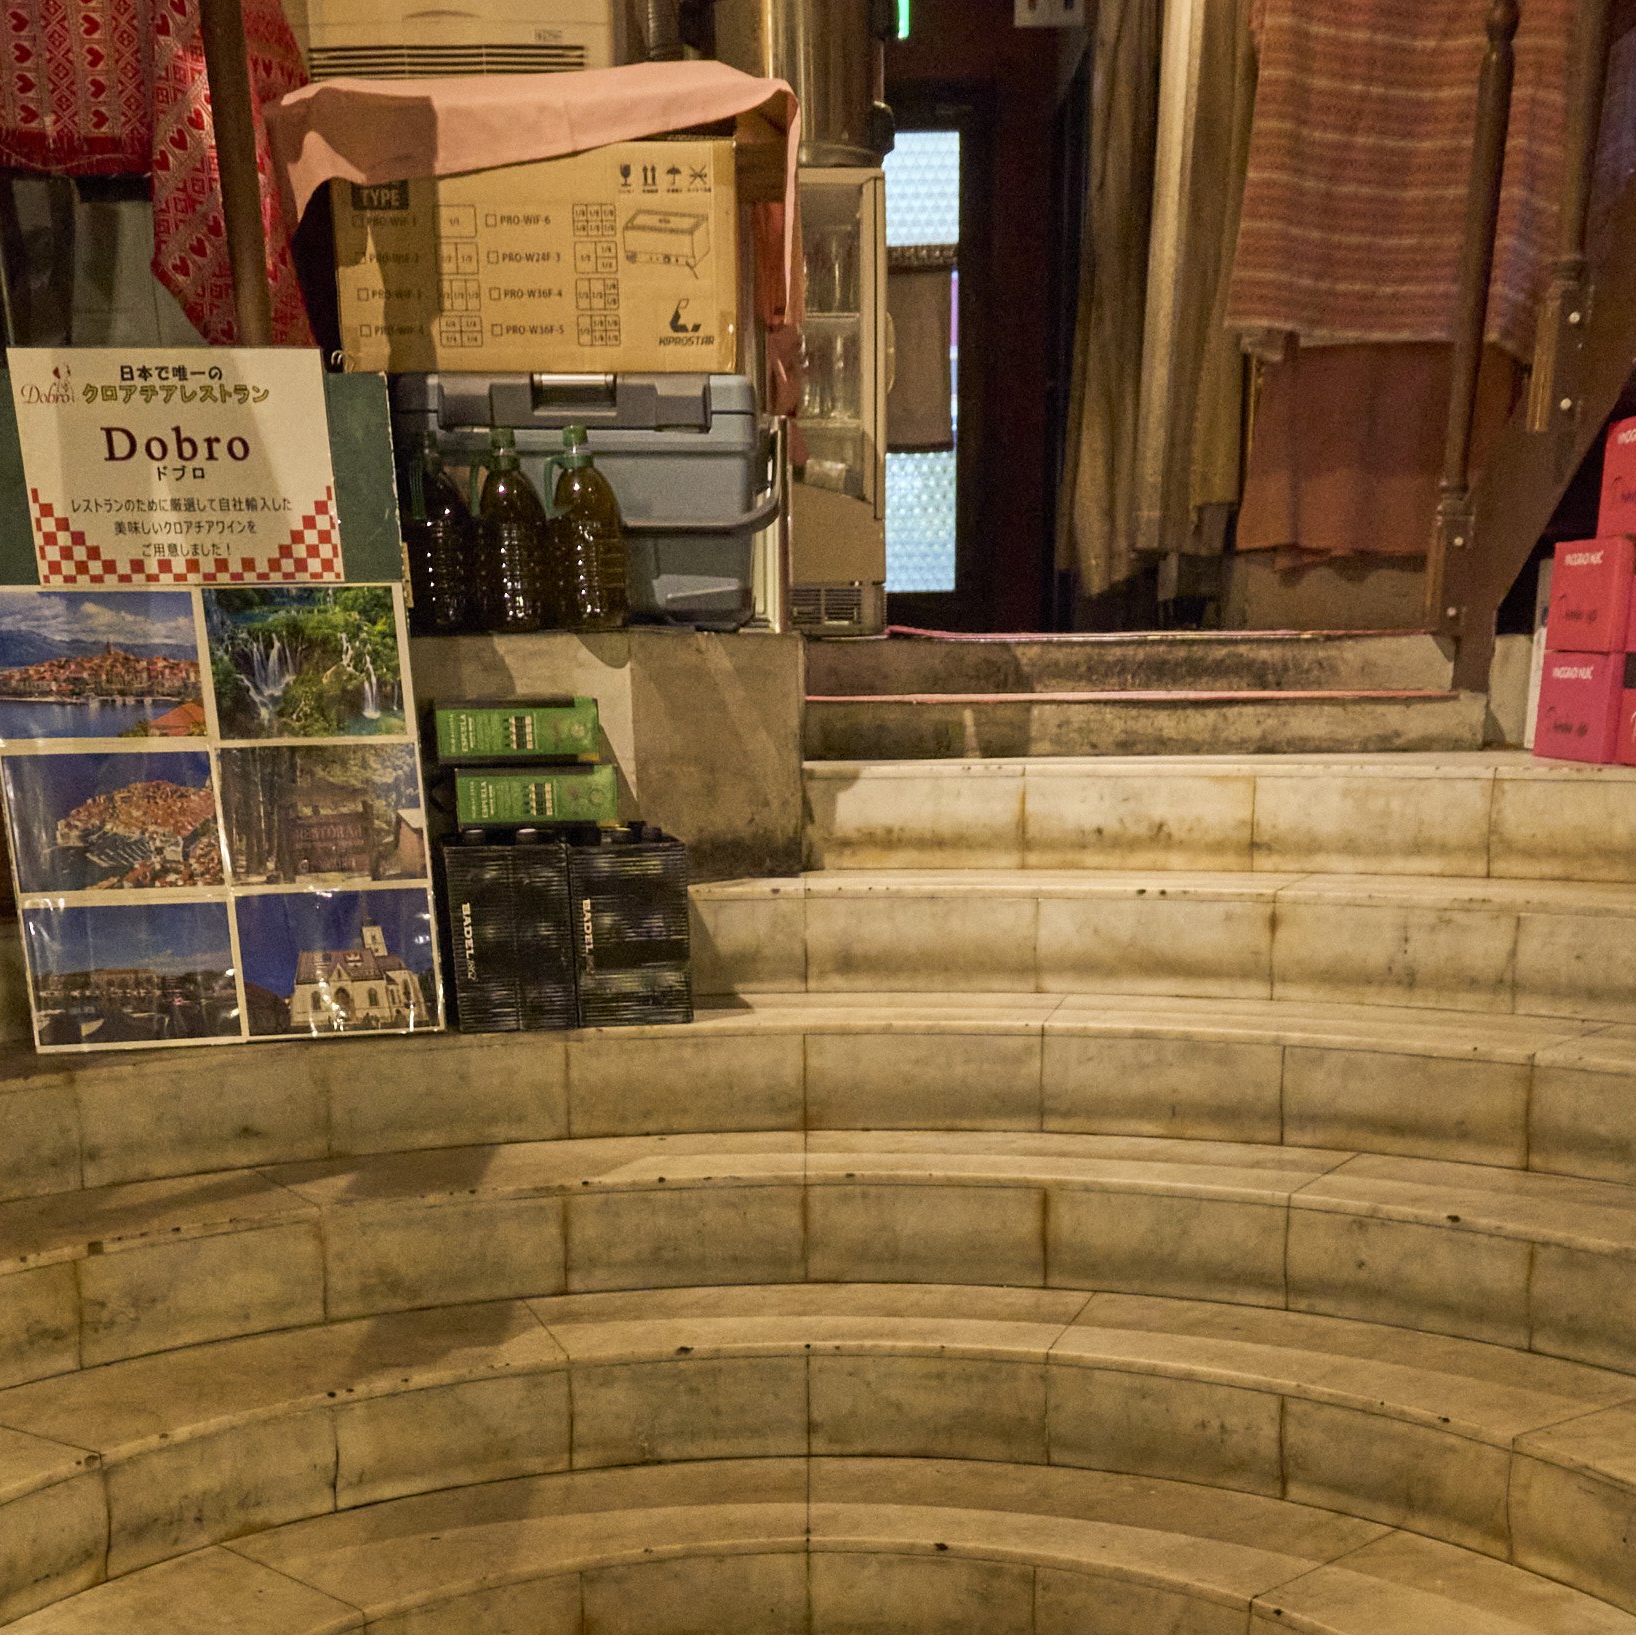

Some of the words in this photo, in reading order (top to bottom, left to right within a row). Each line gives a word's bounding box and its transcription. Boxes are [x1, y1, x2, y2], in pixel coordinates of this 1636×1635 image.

[362, 188, 400, 206] TYPE
[120, 365, 223, 382] 日本で唯一の
[82, 384, 270, 404] クロアチアレストラン
[100, 425, 251, 462] Dobro
[157, 466, 206, 481] ドブロ
[71, 497, 292, 514] レストランのために厳選して自社輸入した
[114, 520, 257, 536] 美味しいクロアチアワインを
[462, 902, 475, 960] BADEL
[582, 899, 594, 955] BADEL
